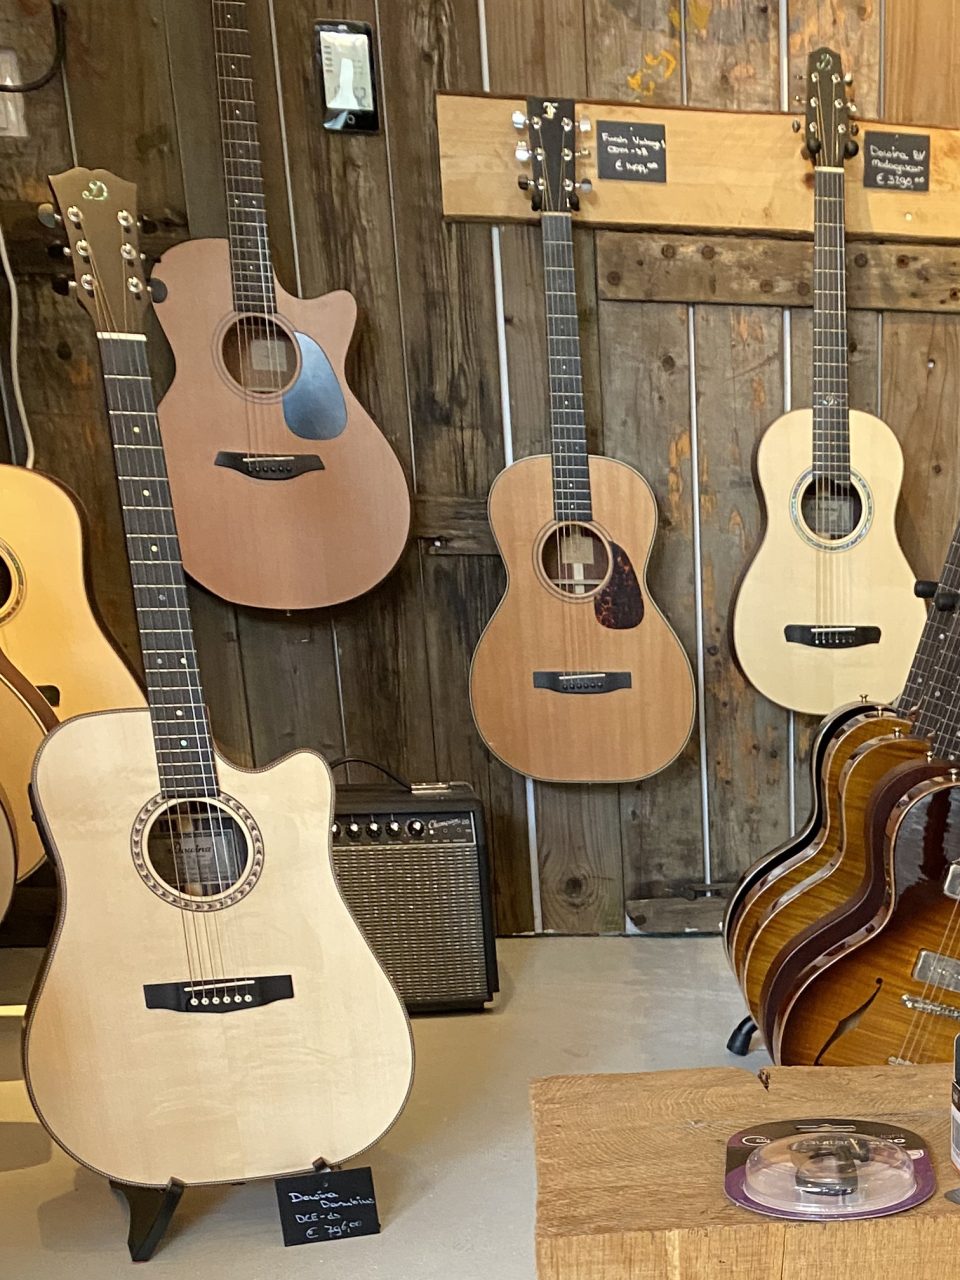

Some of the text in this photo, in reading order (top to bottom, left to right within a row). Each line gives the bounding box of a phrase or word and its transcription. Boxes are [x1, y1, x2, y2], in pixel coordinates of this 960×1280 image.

[870, 145, 909, 160] Dowina
[288, 1190, 339, 1203] Dowina
[306, 1226, 319, 1239] €
